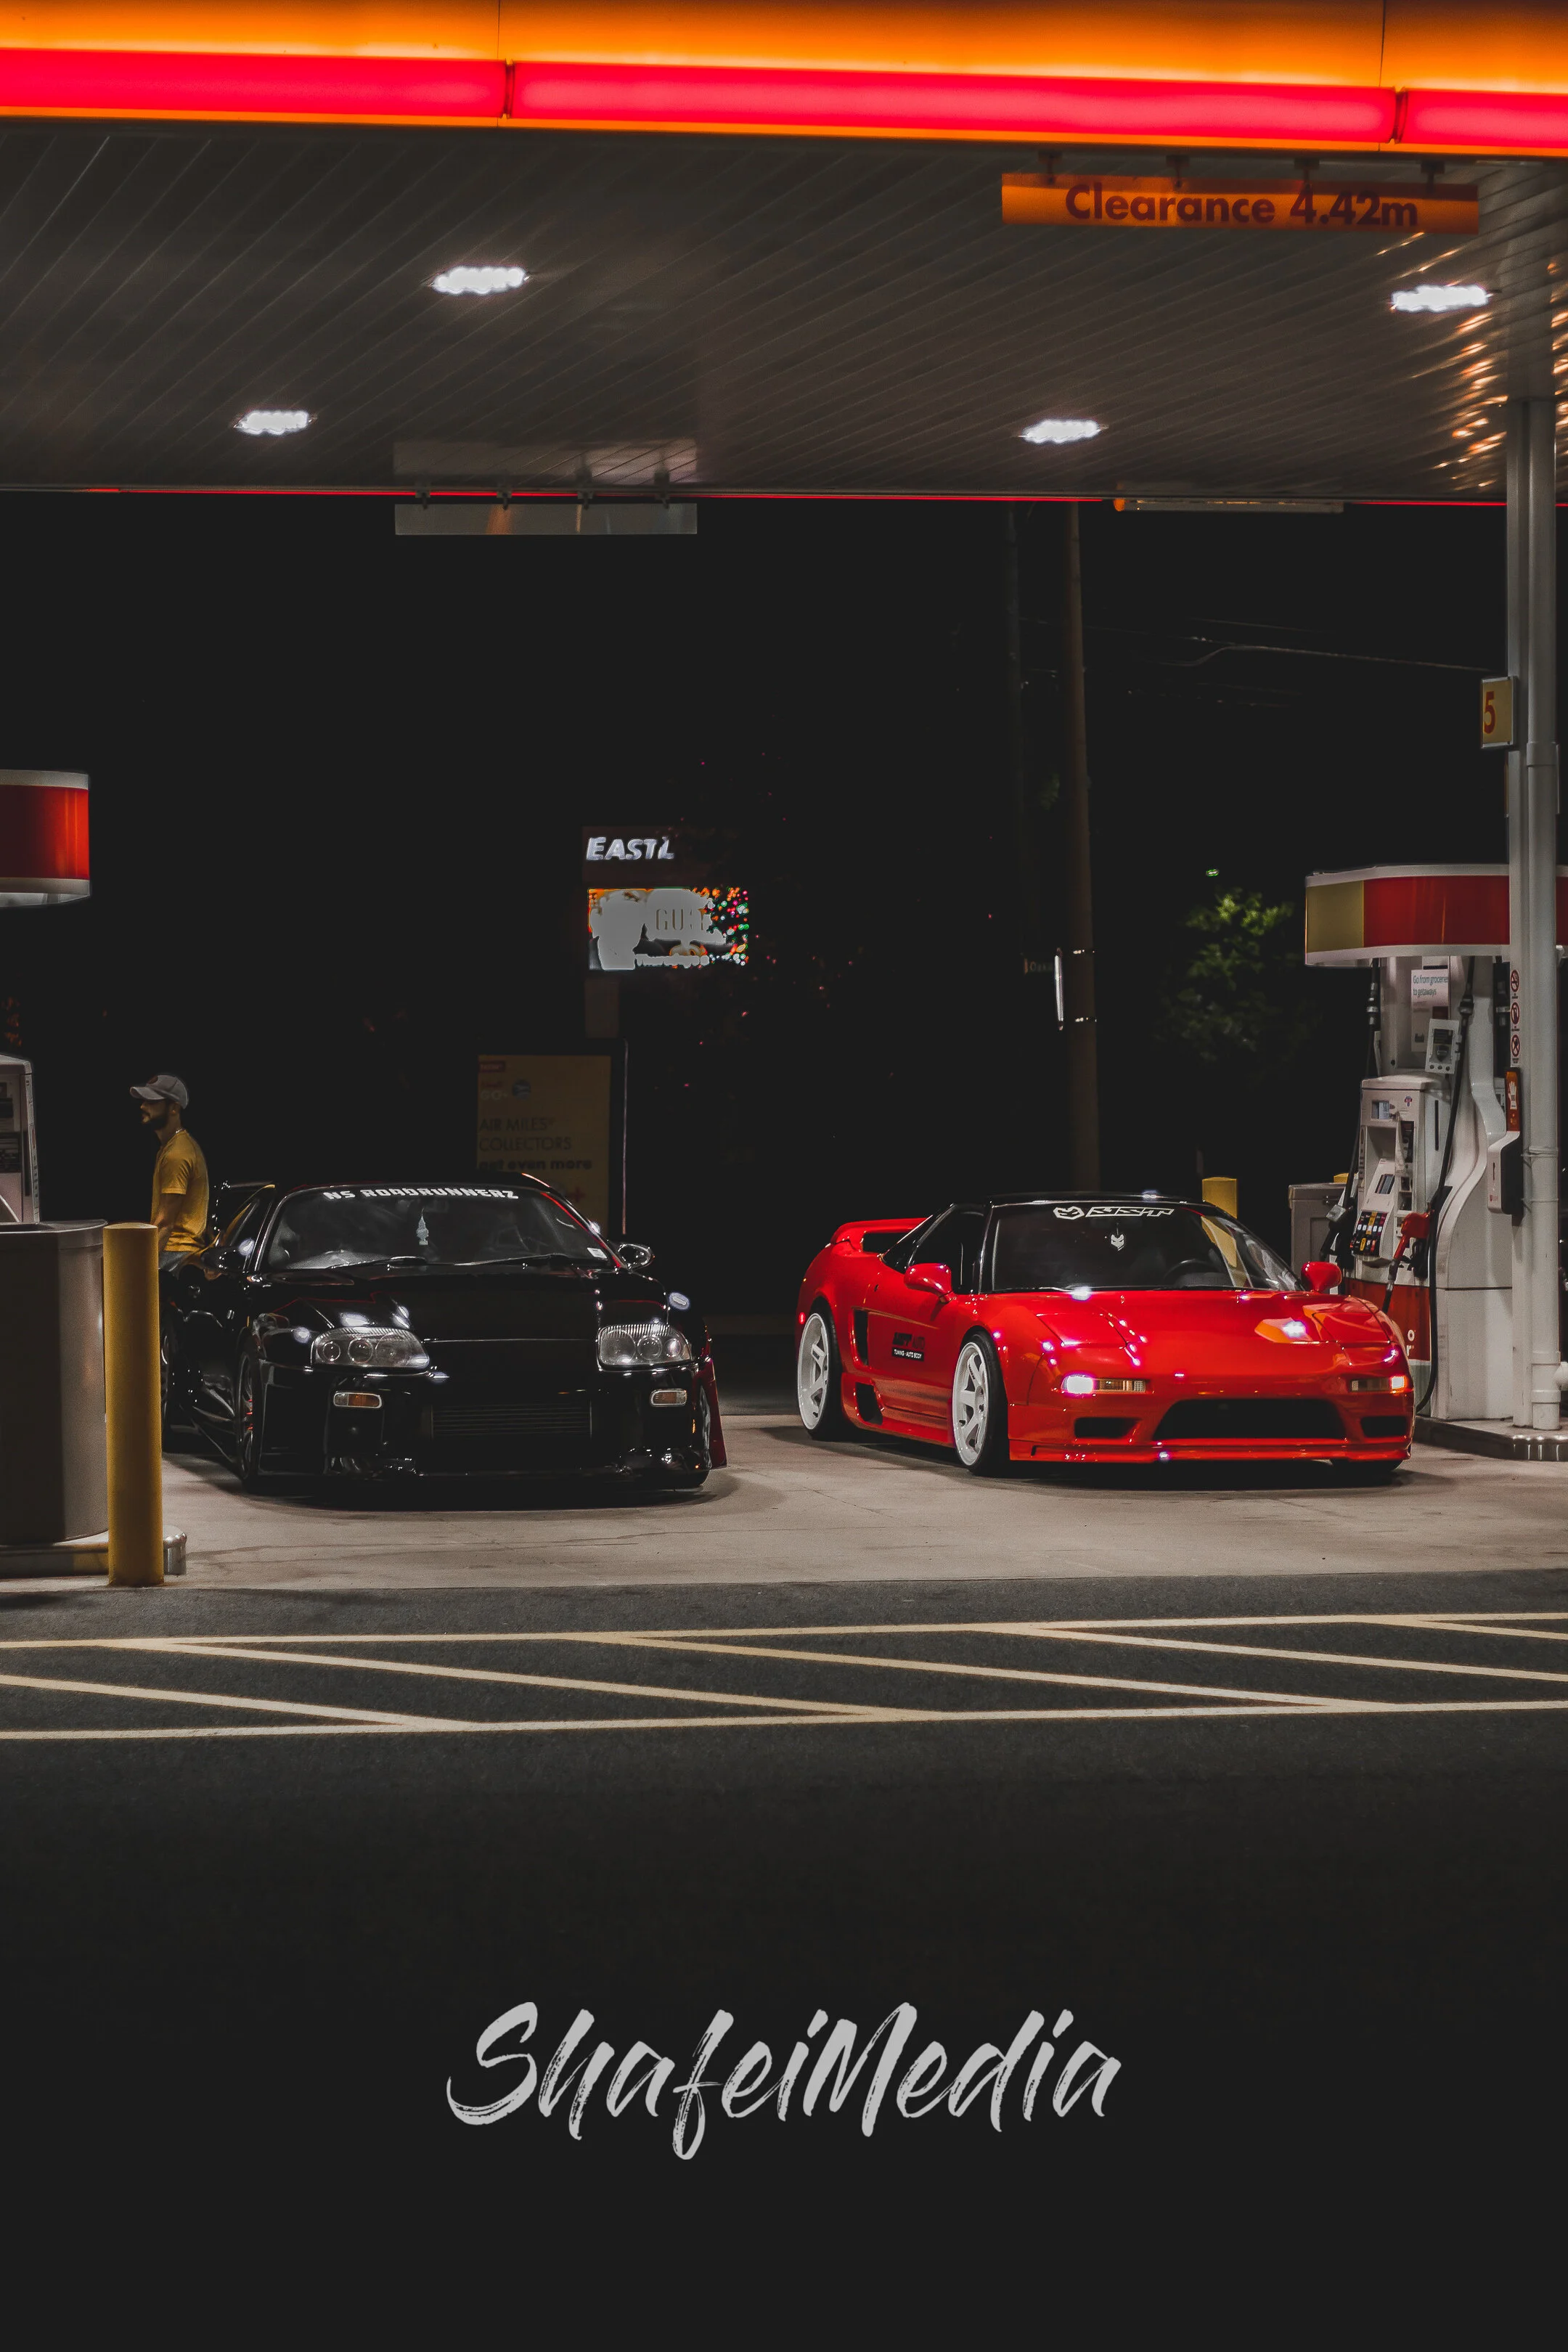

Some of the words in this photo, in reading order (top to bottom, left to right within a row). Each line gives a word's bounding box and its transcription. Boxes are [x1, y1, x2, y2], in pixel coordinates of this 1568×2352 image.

[1066, 182, 1275, 224] Clearance
[1290, 185, 1418, 227] 4.42m
[1484, 690, 1496, 734] 5
[479, 1119, 502, 1132] AIR
[479, 1137, 572, 1152] COLLECTORS
[507, 1159, 546, 1170] even
[550, 1159, 592, 1170] more
[322, 1190, 356, 1200] NS
[360, 1187, 519, 1200] ROADRUNNERZ
